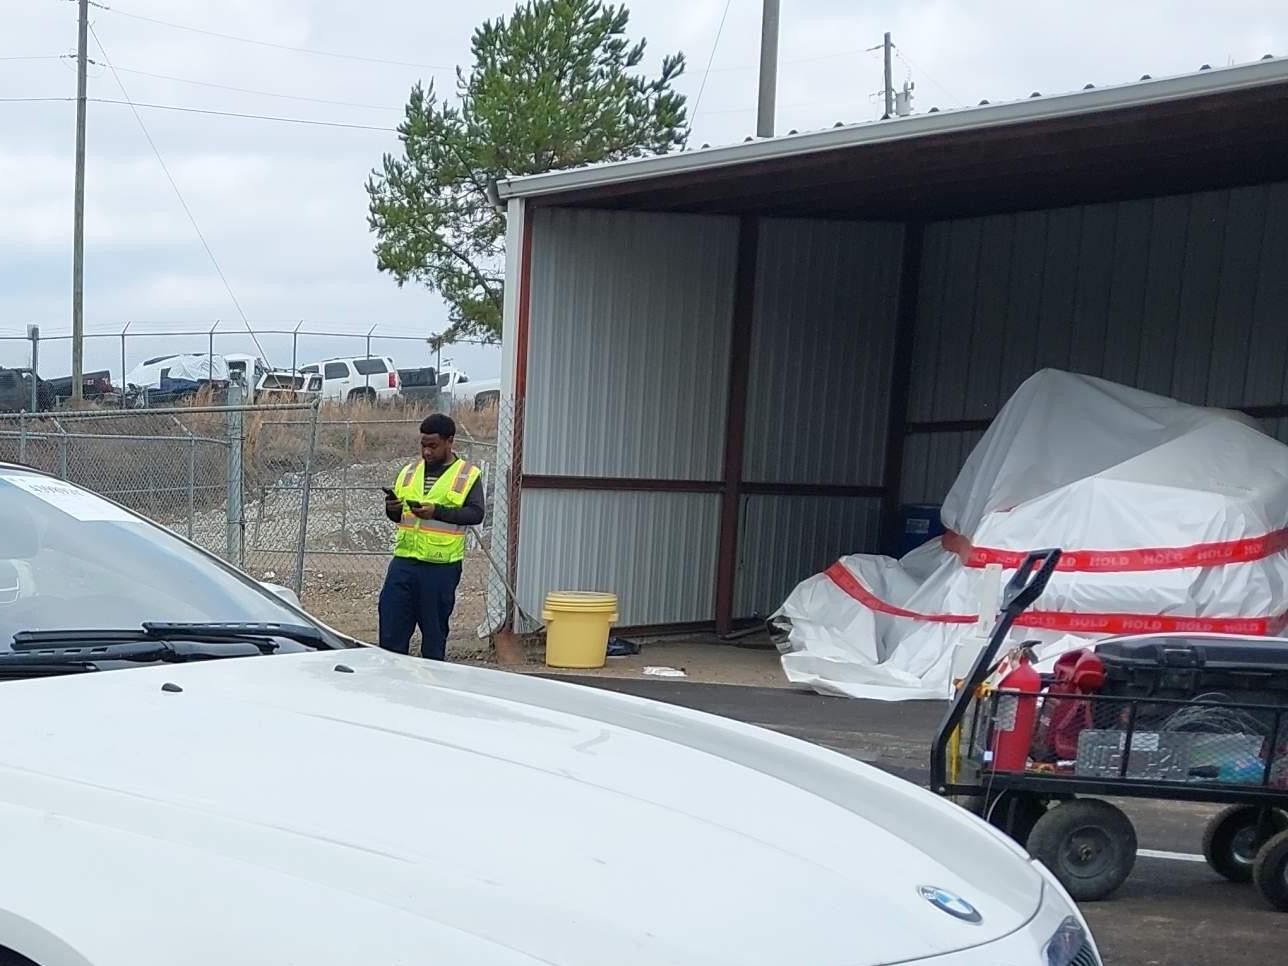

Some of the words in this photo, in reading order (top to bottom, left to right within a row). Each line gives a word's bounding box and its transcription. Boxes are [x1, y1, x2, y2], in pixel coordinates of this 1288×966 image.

[1090, 556, 1129, 567] HOLD
[1143, 552, 1184, 564] HOLD
[1197, 549, 1233, 561] HOLD
[1069, 616, 1110, 627] HOLD
[1122, 619, 1162, 630] HOLD
[1175, 621, 1213, 632] HOLD
[1224, 623, 1259, 633] HOLD
